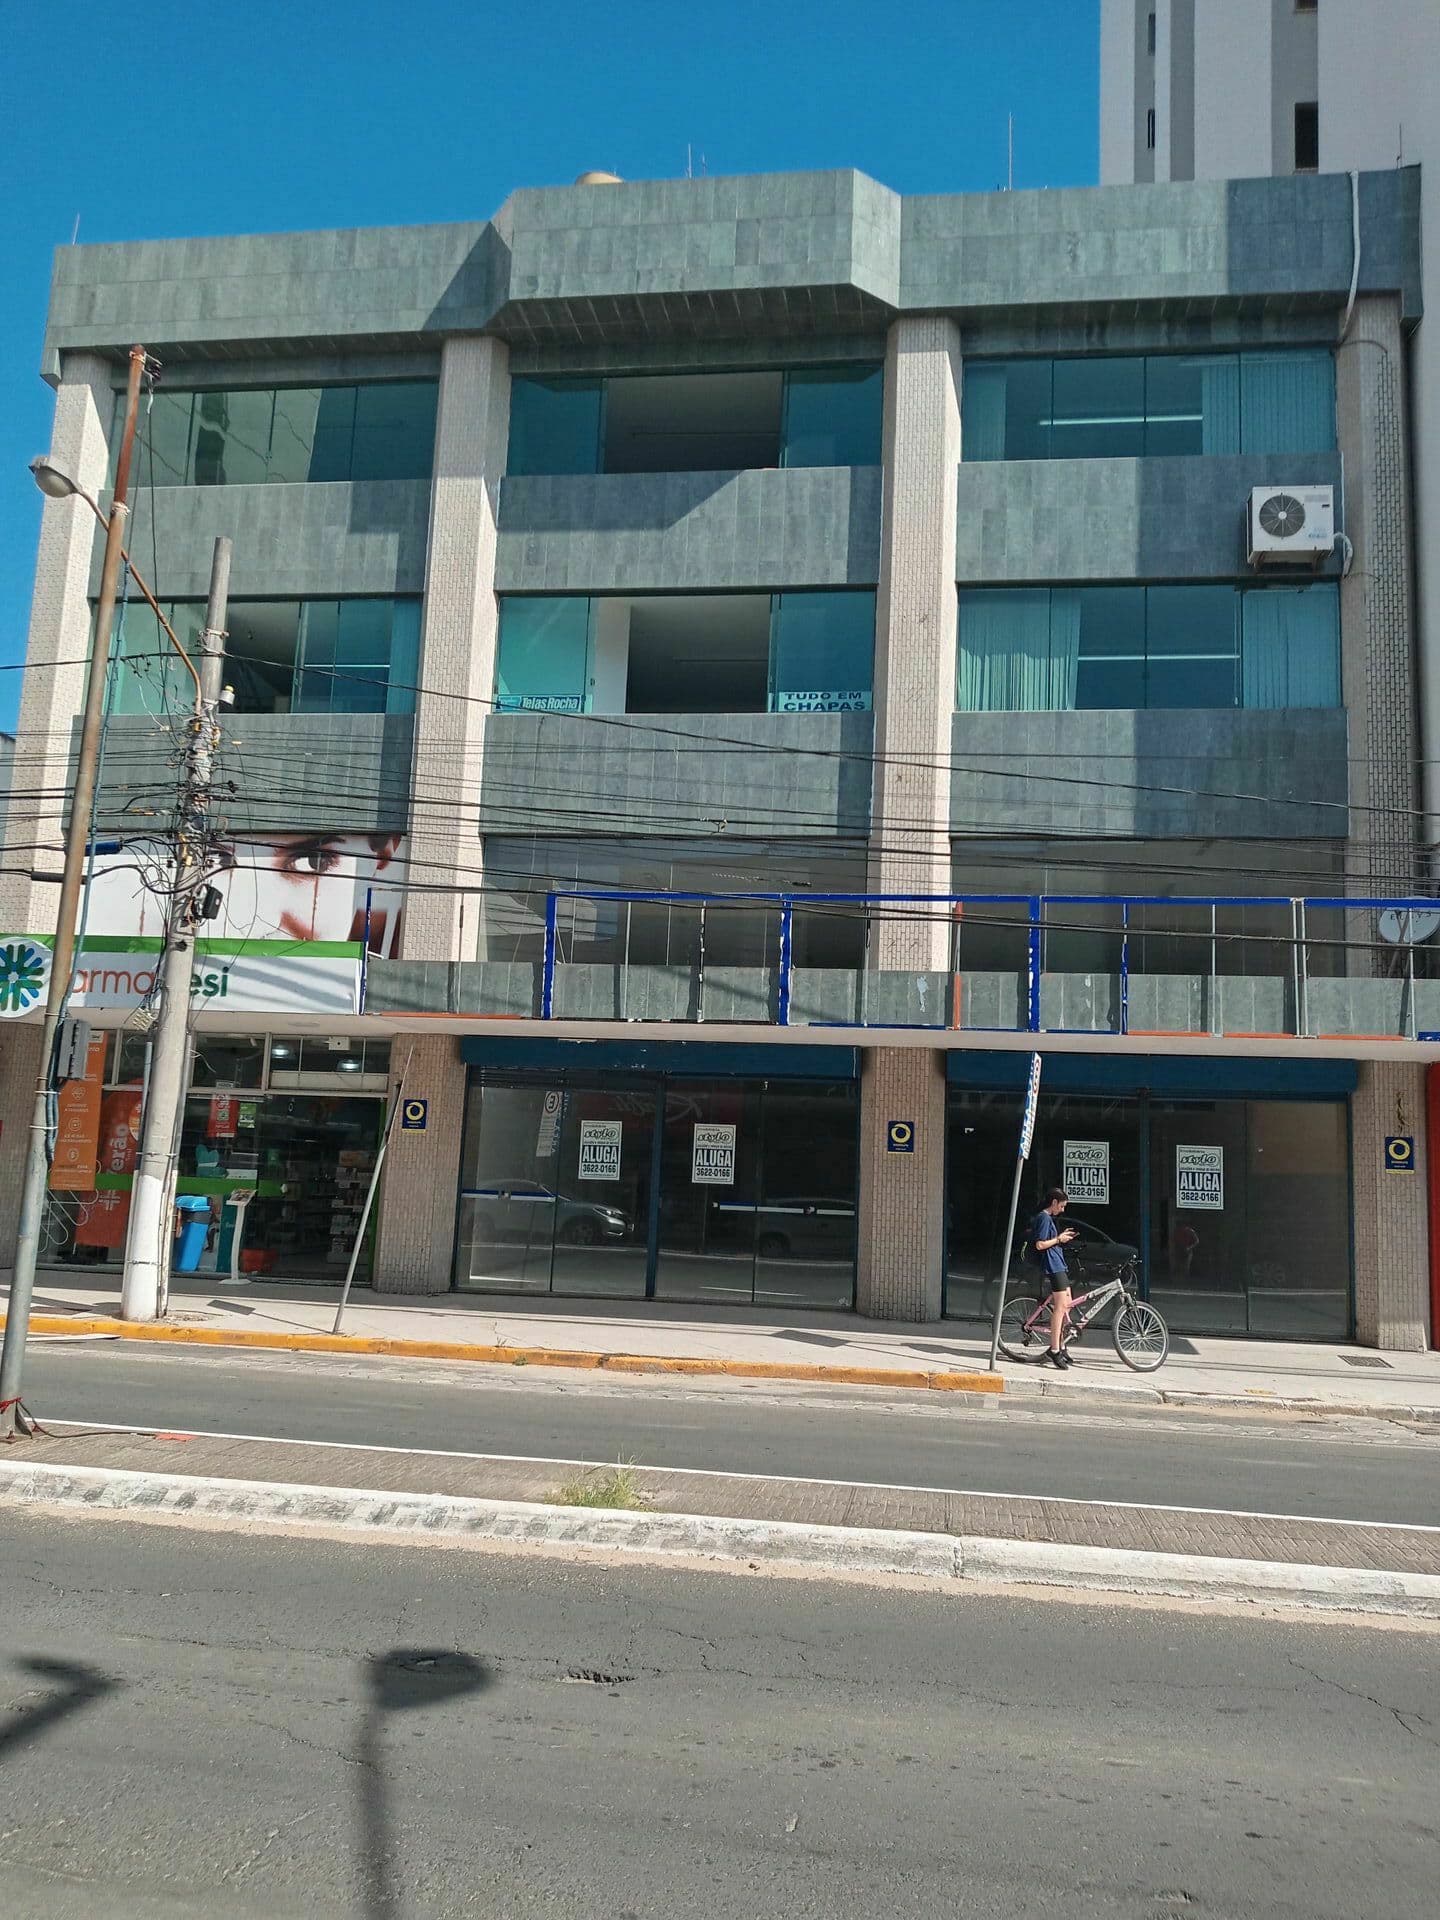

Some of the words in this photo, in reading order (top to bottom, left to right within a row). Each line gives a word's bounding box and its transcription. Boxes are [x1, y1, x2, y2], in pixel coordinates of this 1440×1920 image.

[785, 692, 832, 700] TUDO
[837, 692, 862, 700] EM
[783, 701, 866, 711] CHAPAS
[582, 1145, 617, 1163] ALUGA
[696, 1149, 731, 1167] ALUGA
[696, 1167, 730, 1178] 3622-0166
[1067, 1167, 1106, 1186] ALUGA
[1180, 1172, 1220, 1191] ALUGA
[1067, 1186, 1105, 1197] 3622-0166
[1181, 1191, 1219, 1202] 3622-0166
